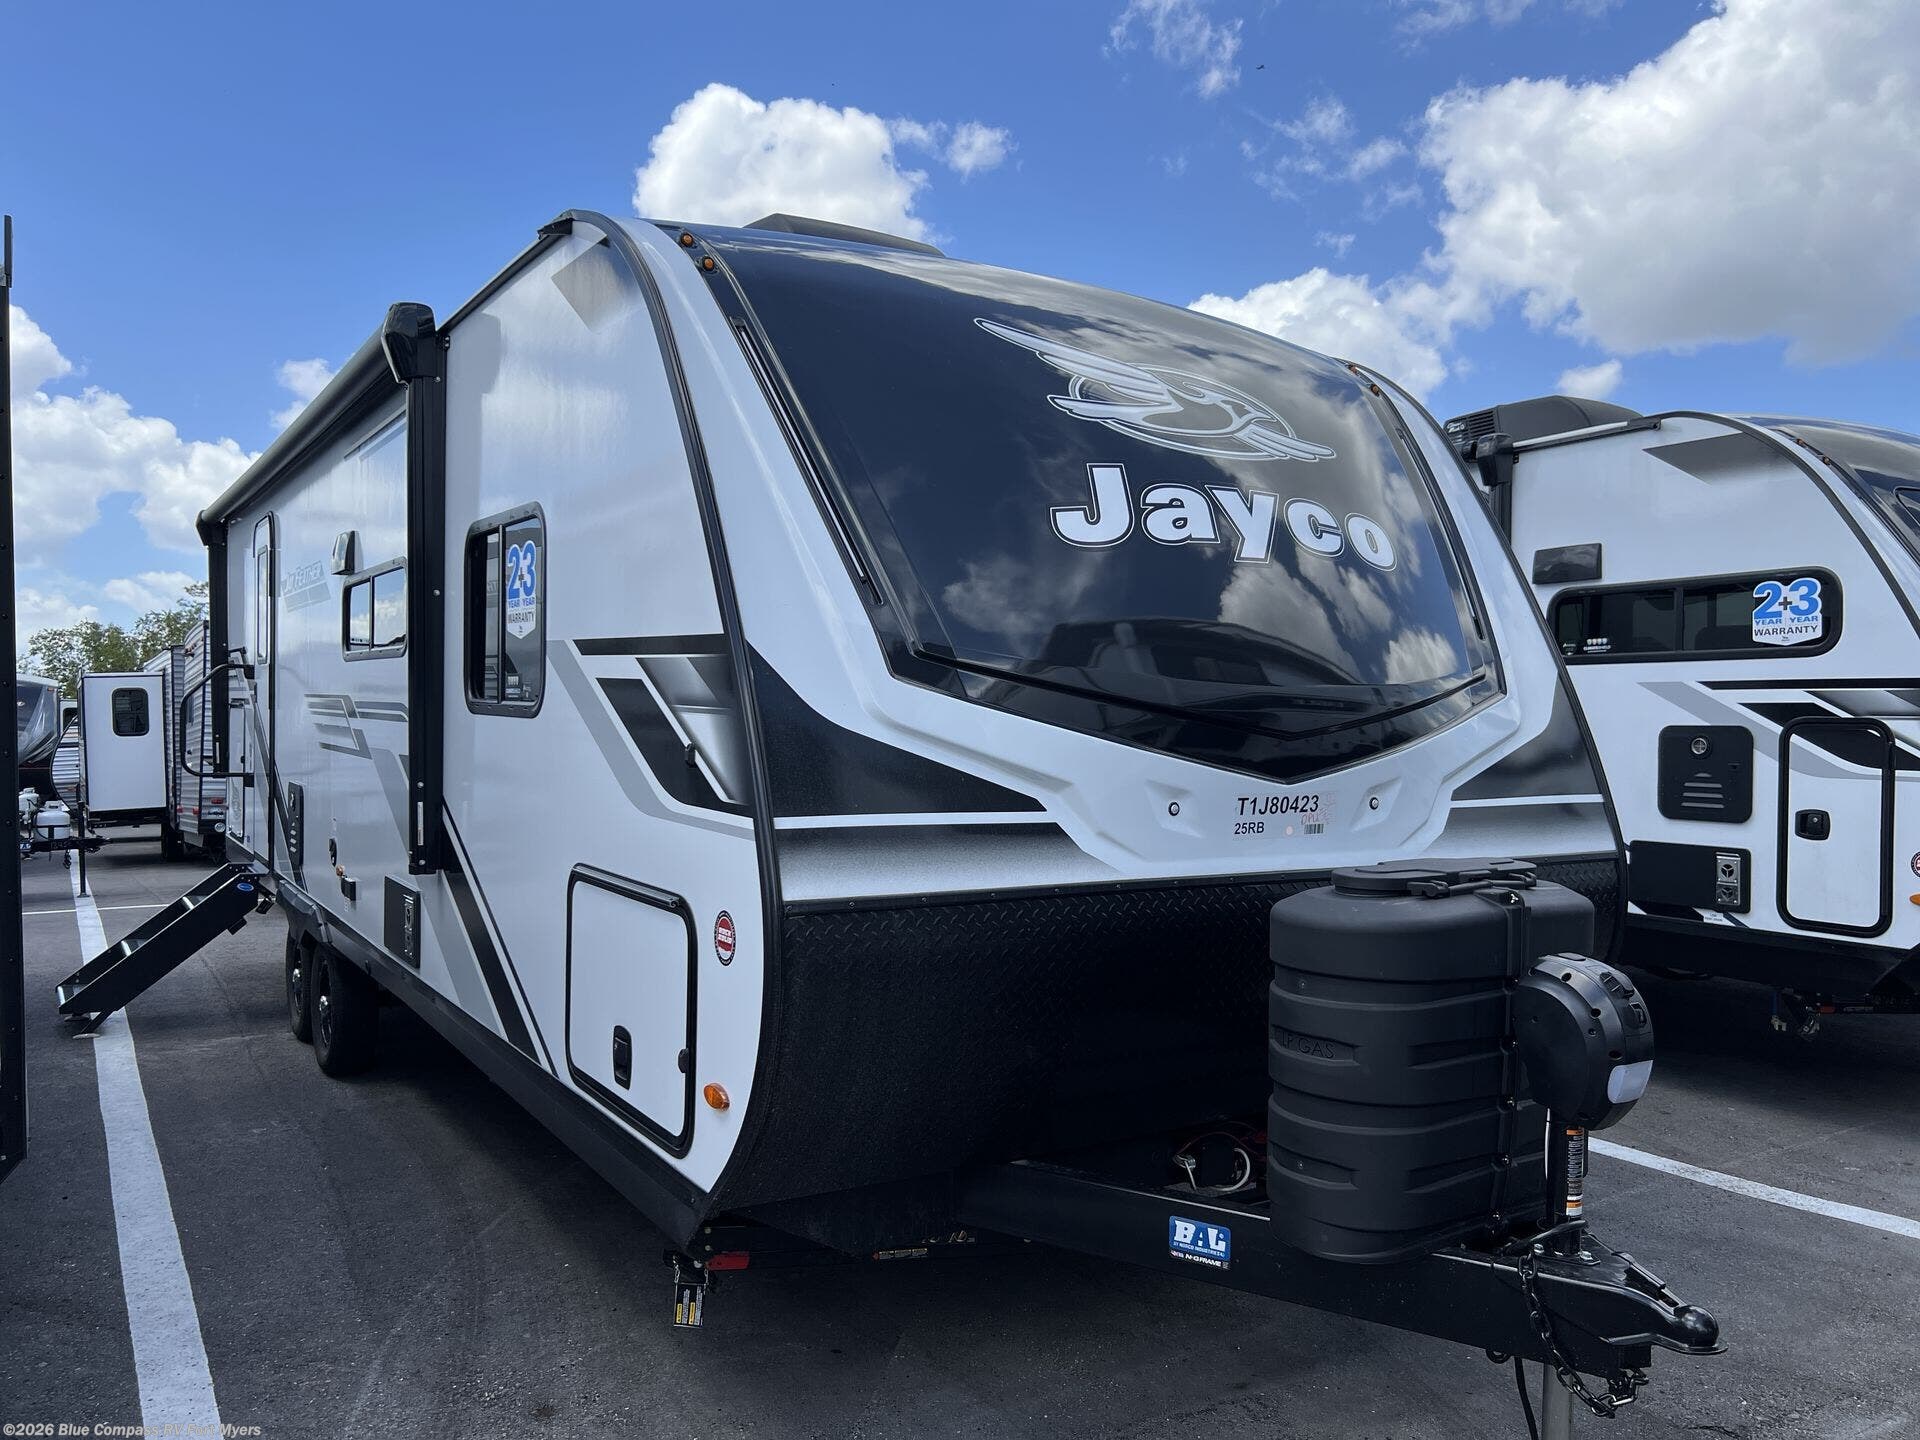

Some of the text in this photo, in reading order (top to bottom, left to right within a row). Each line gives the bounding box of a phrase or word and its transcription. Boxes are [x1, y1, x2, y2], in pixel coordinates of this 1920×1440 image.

[1050, 463, 1397, 571] Jayco
[523, 598, 535, 607] YEAR
[507, 611, 534, 623] WARRANTY
[1755, 615, 1818, 626] YEAR YEAR
[1754, 625, 1818, 636] WARRANTY
[1237, 795, 1320, 815] T1J80423
[1234, 821, 1265, 834] 25RB
[1298, 1037, 1335, 1058] GAS
[1174, 1220, 1226, 1251] BAL
